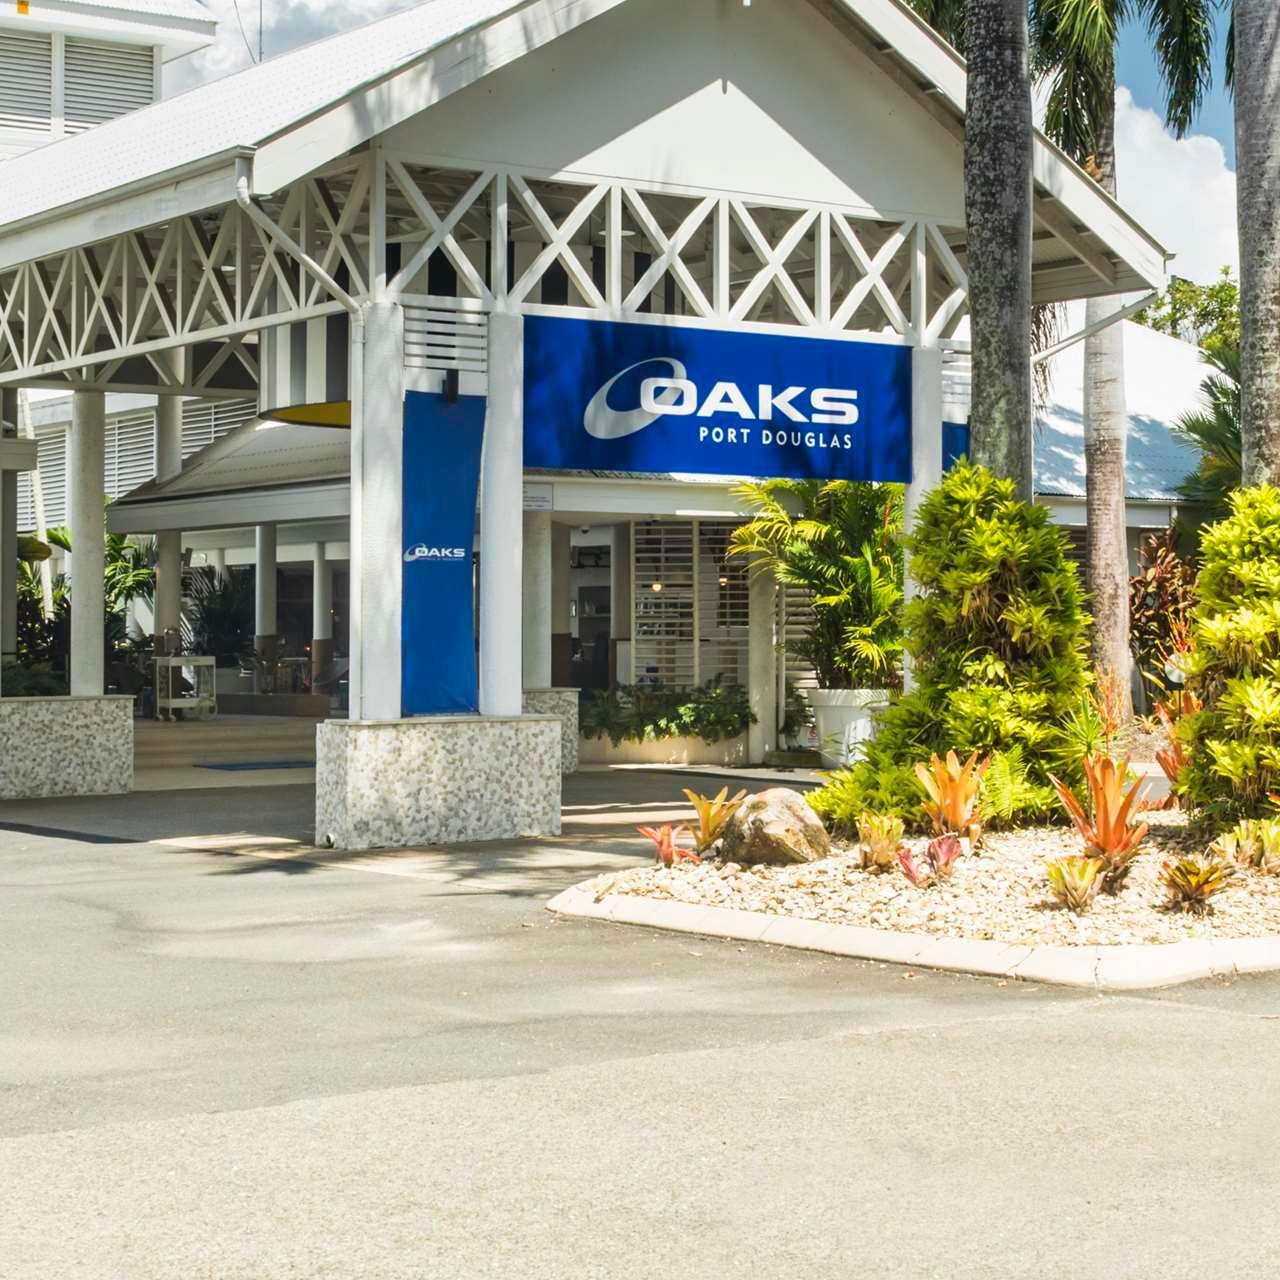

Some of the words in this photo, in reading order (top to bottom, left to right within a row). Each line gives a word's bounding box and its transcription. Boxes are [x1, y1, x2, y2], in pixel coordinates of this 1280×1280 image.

[640, 377, 859, 425] OAKS
[698, 426, 751, 444] PORT
[761, 428, 852, 449] DOUGLAS
[415, 547, 465, 557] OAKS
